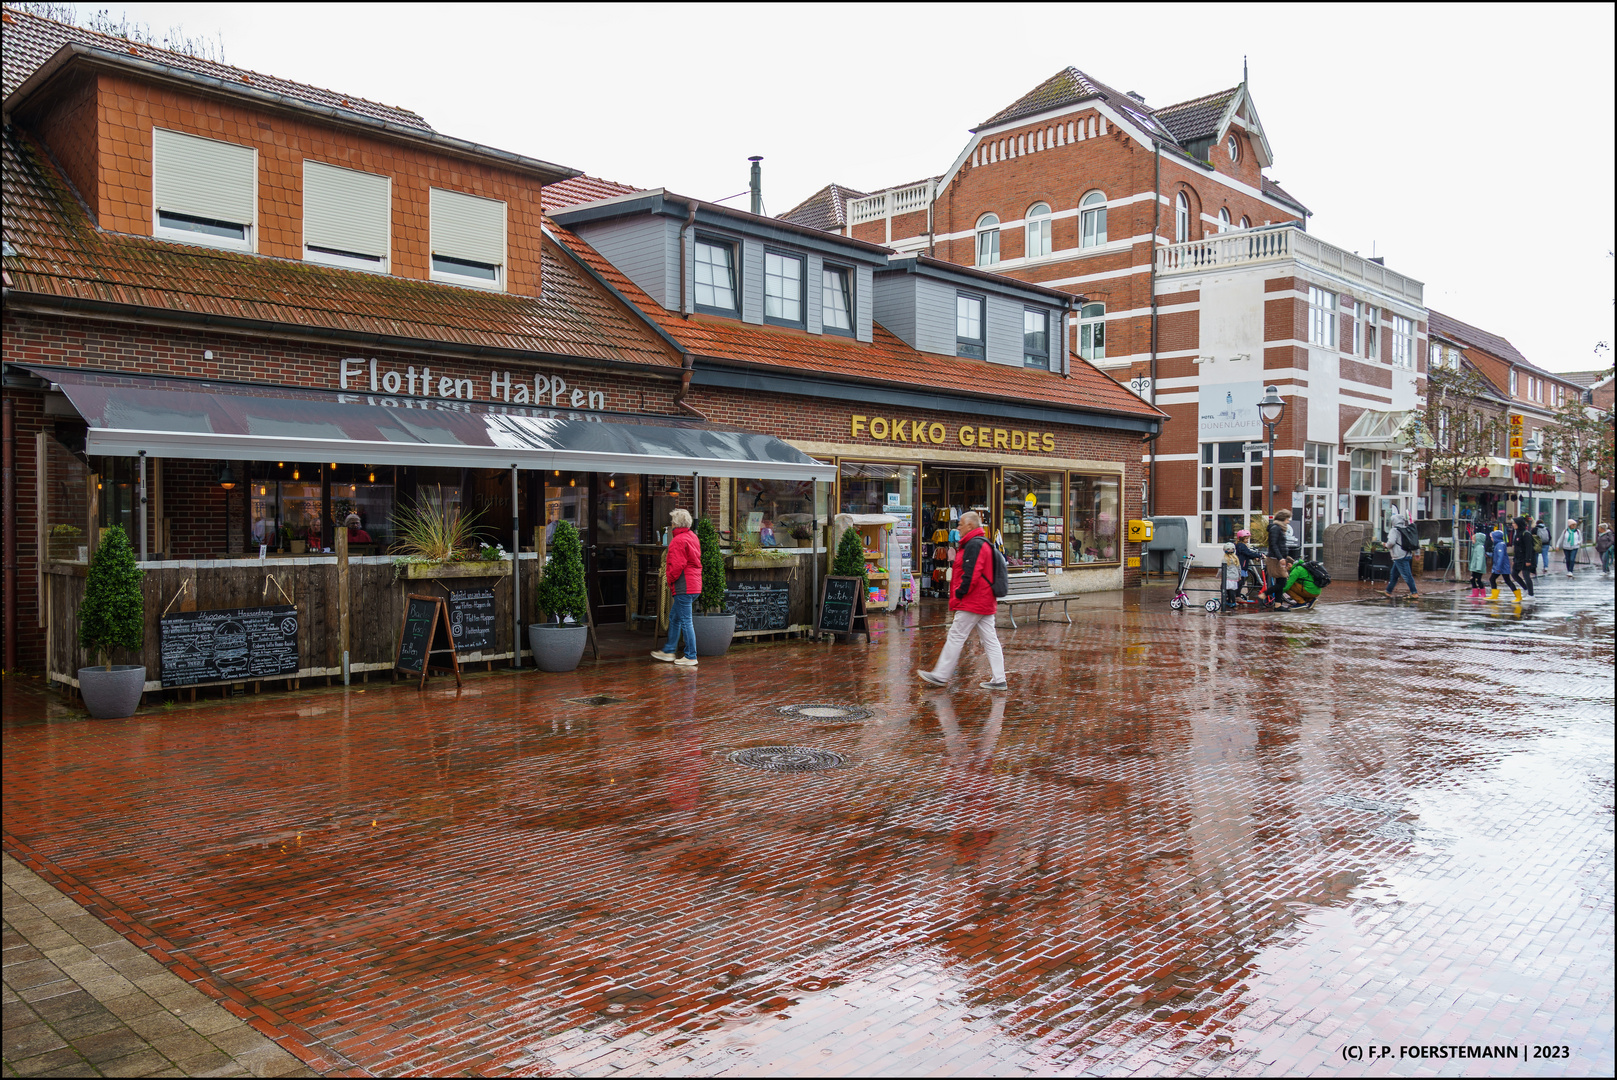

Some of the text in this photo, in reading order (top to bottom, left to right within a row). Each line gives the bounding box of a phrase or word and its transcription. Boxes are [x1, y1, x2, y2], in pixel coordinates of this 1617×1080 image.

[340, 357, 473, 400] Flotten
[851, 414, 1056, 453] FOKKO GERDES
[1201, 420, 1261, 430] DÜNENLÄUFER
